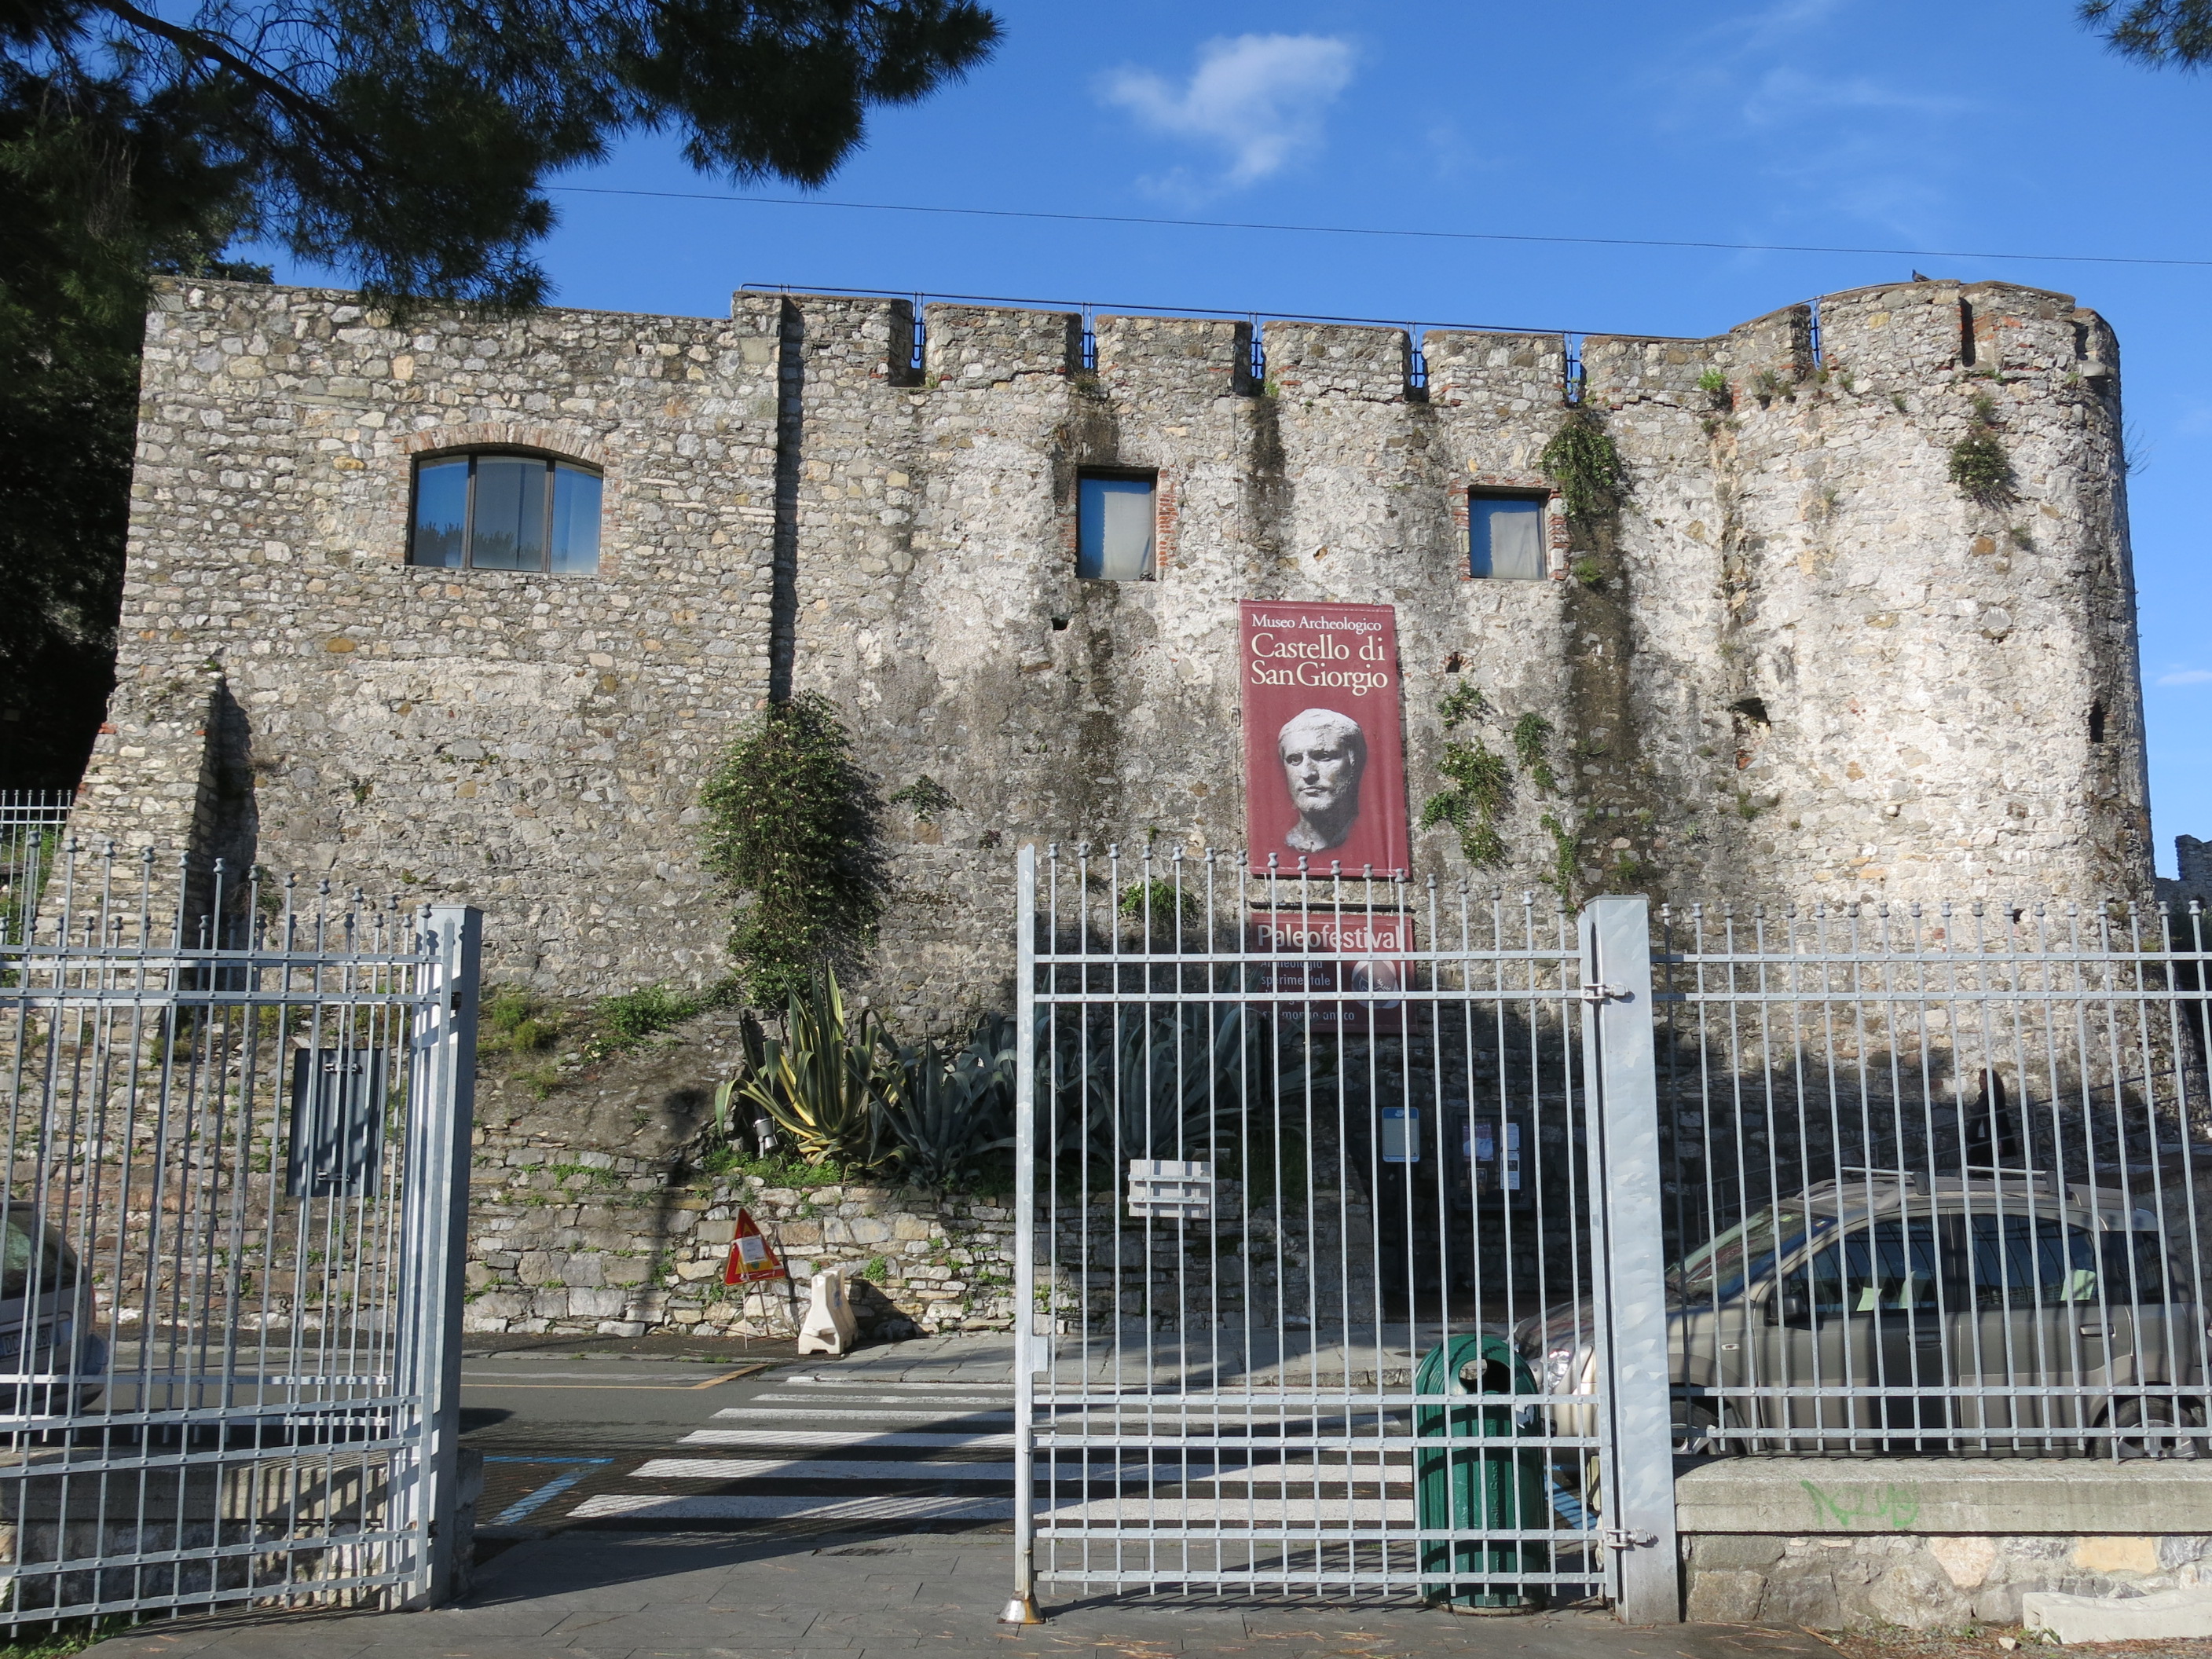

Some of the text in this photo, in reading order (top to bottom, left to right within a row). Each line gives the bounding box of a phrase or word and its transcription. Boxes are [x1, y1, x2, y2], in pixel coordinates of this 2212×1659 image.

[1251, 613, 1382, 635] Museo Archeologico
[1251, 632, 1386, 661] Castello di
[1261, 973, 1331, 987] sprimetale
